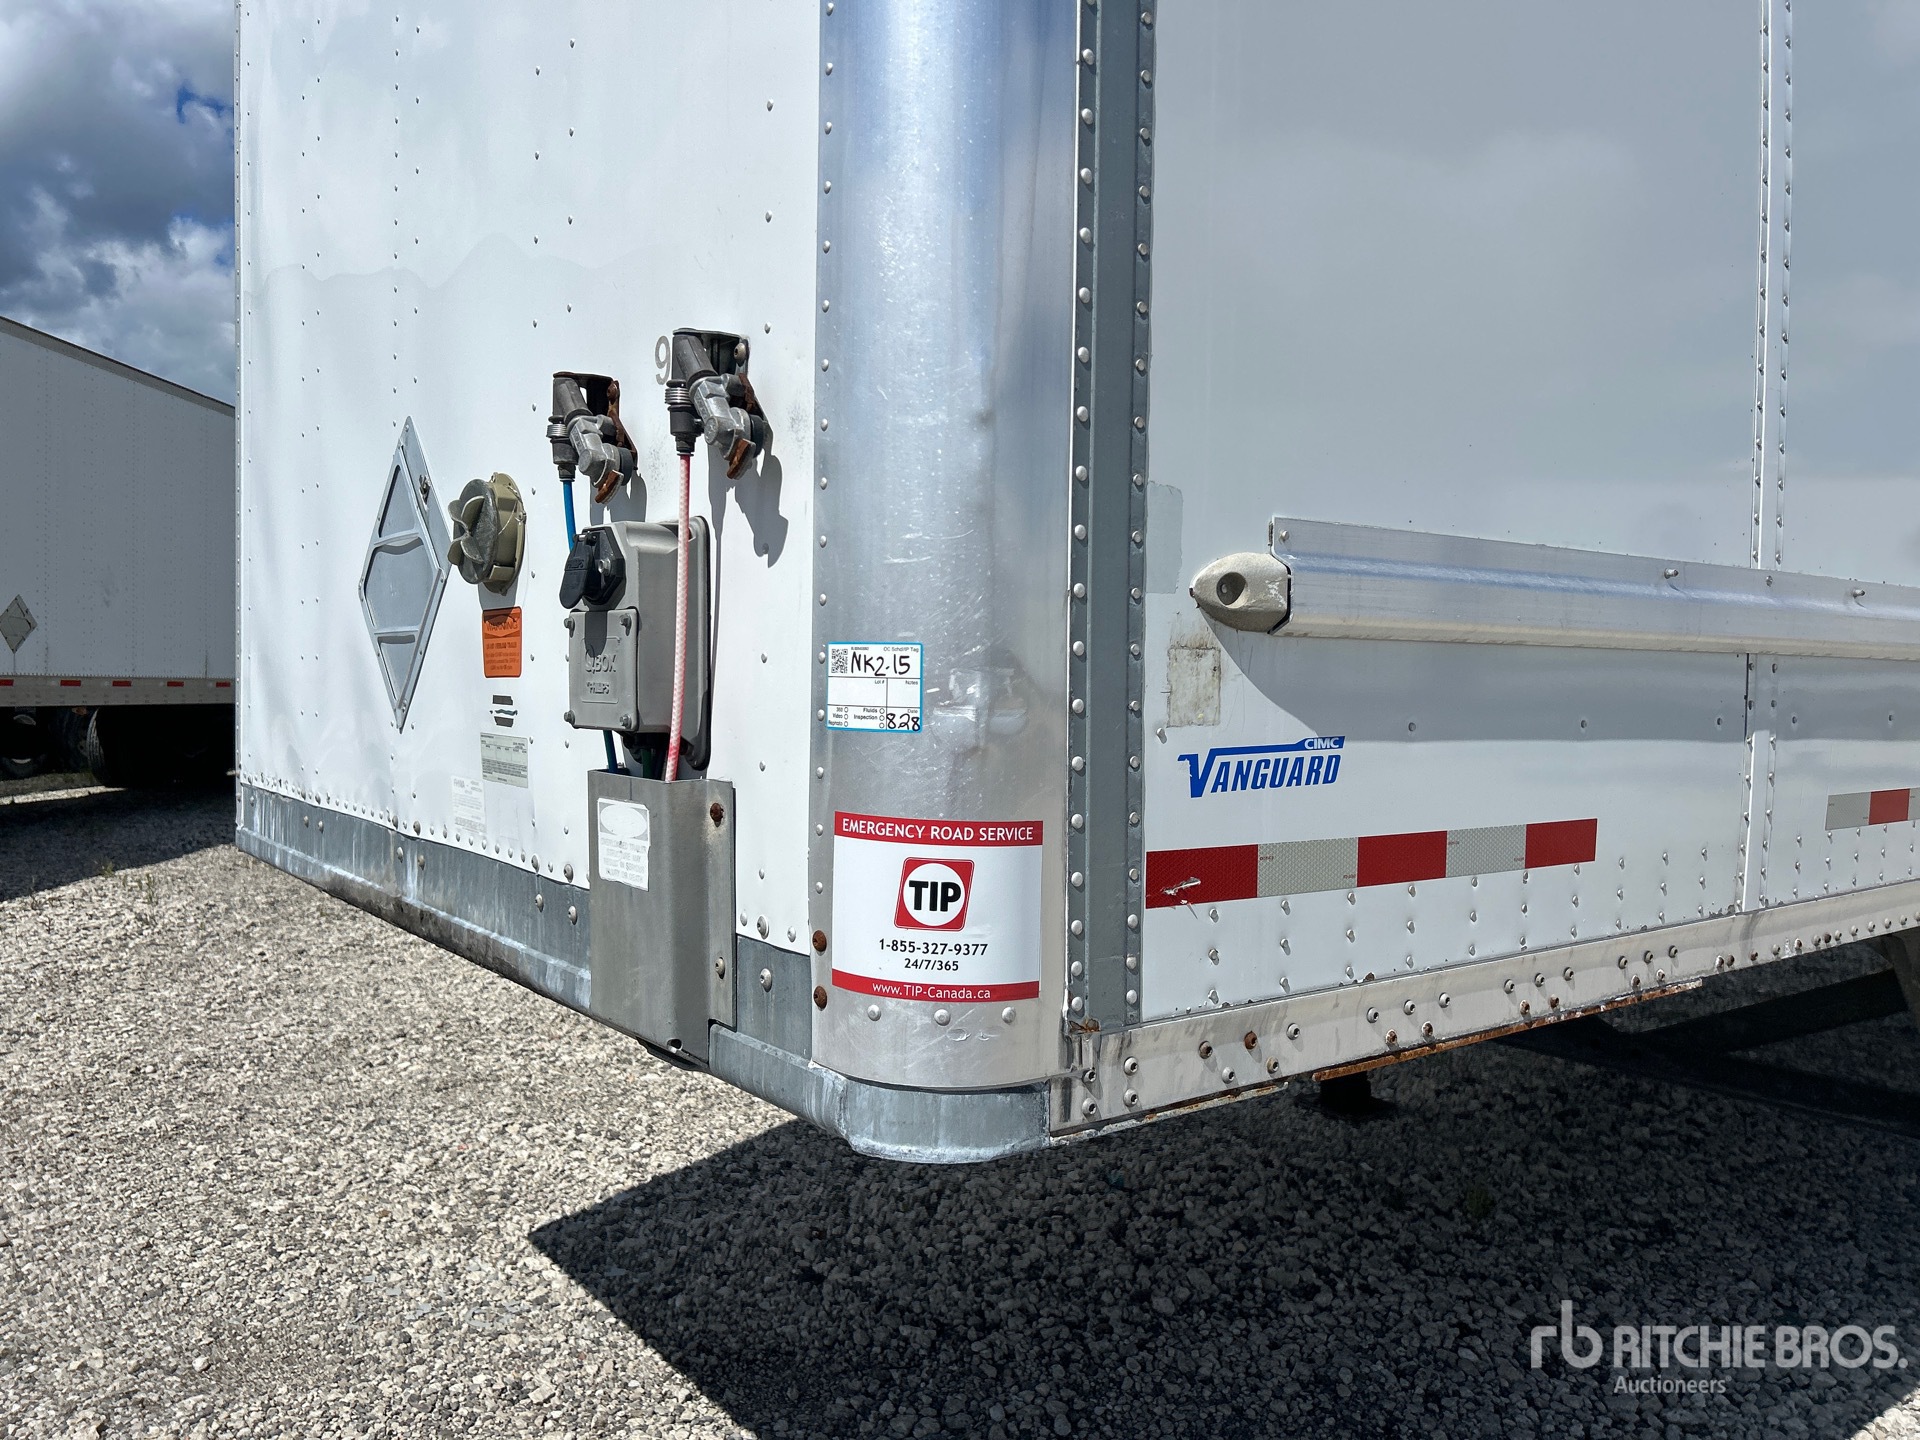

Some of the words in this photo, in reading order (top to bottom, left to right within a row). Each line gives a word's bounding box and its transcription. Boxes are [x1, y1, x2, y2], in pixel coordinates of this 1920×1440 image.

[1304, 738, 1340, 750] CIMC
[1177, 749, 1341, 798] VANGUARD
[842, 818, 925, 839] EMERGENCY
[930, 827, 974, 841] ROAD
[979, 827, 1034, 841] SERVICE
[908, 880, 962, 912] TIP
[879, 938, 988, 956] 1-855-327-9377
[904, 958, 959, 971] 24/7/365
[872, 982, 991, 999] www.TIP-Canada.ca
